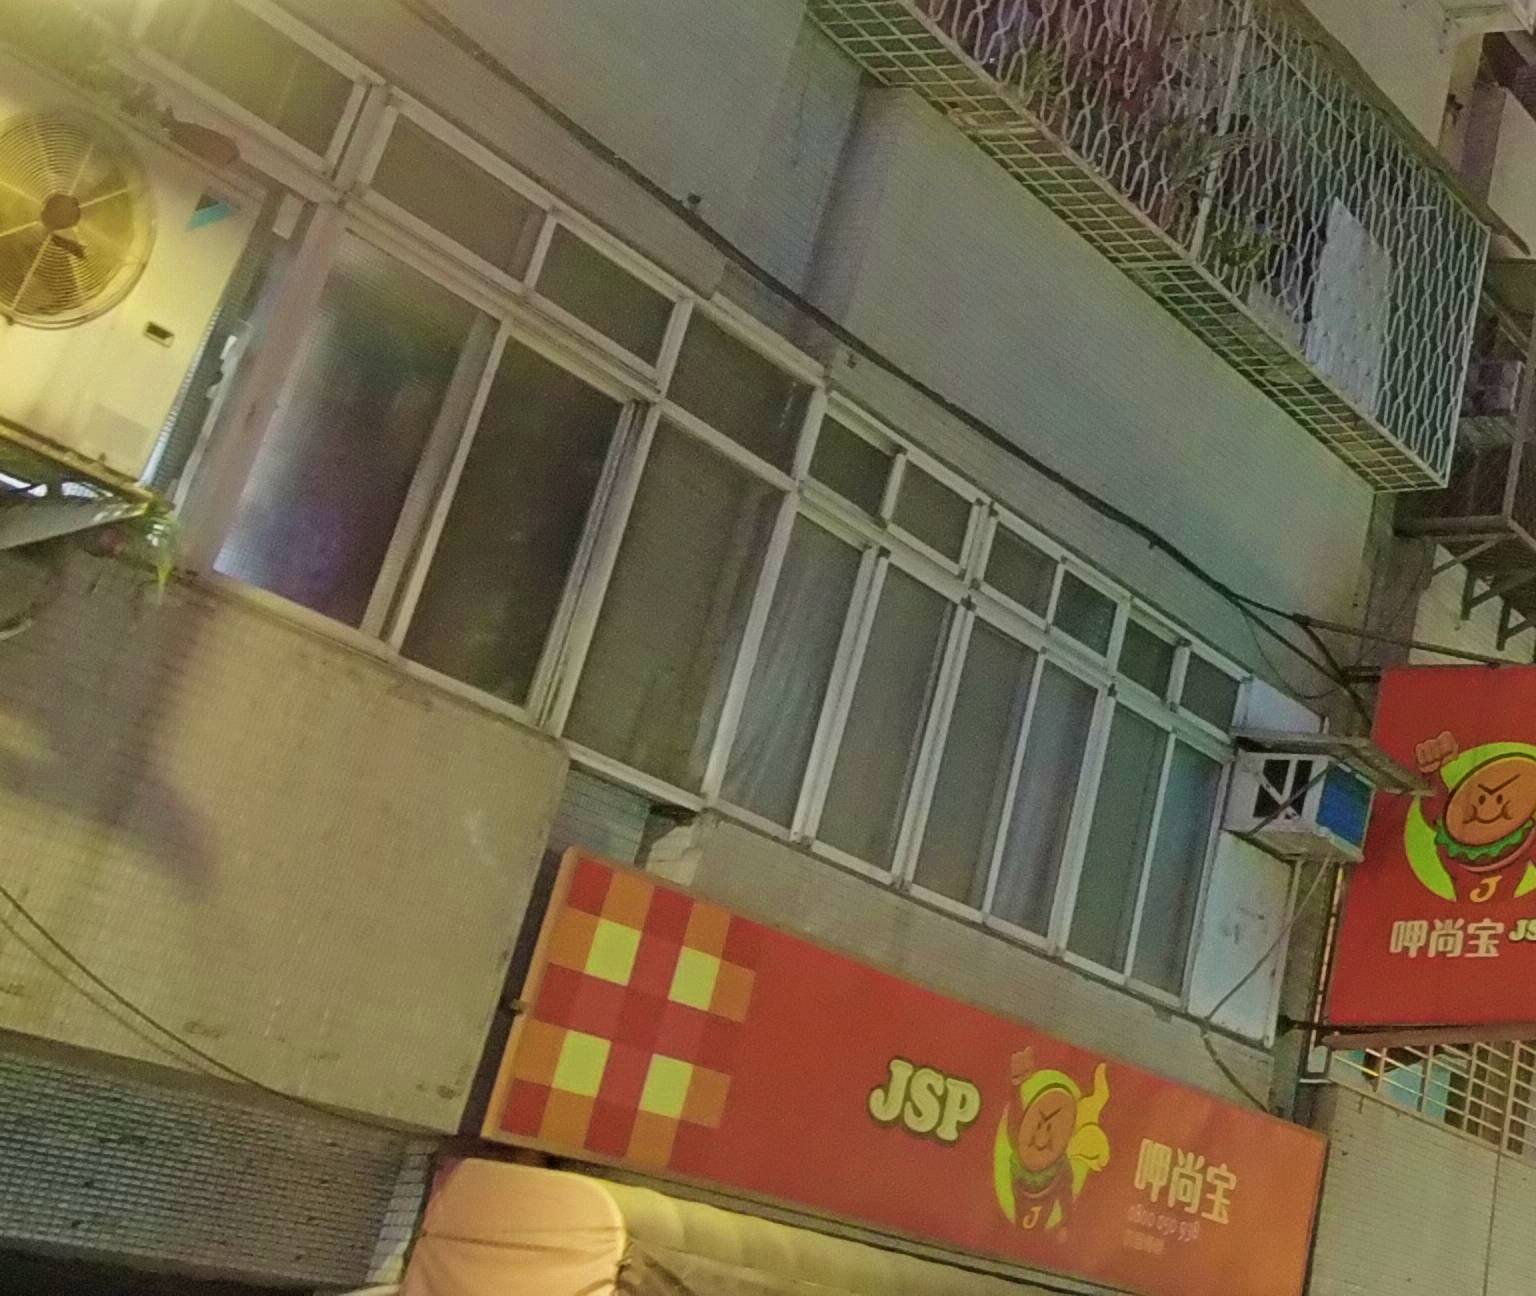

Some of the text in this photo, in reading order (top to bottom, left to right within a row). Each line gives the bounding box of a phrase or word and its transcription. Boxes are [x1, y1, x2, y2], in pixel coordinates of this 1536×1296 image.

[1389, 918, 1504, 958] 呷尚宝
[868, 1057, 982, 1144] JSP
[1134, 1137, 1238, 1225] 呷尚宝
